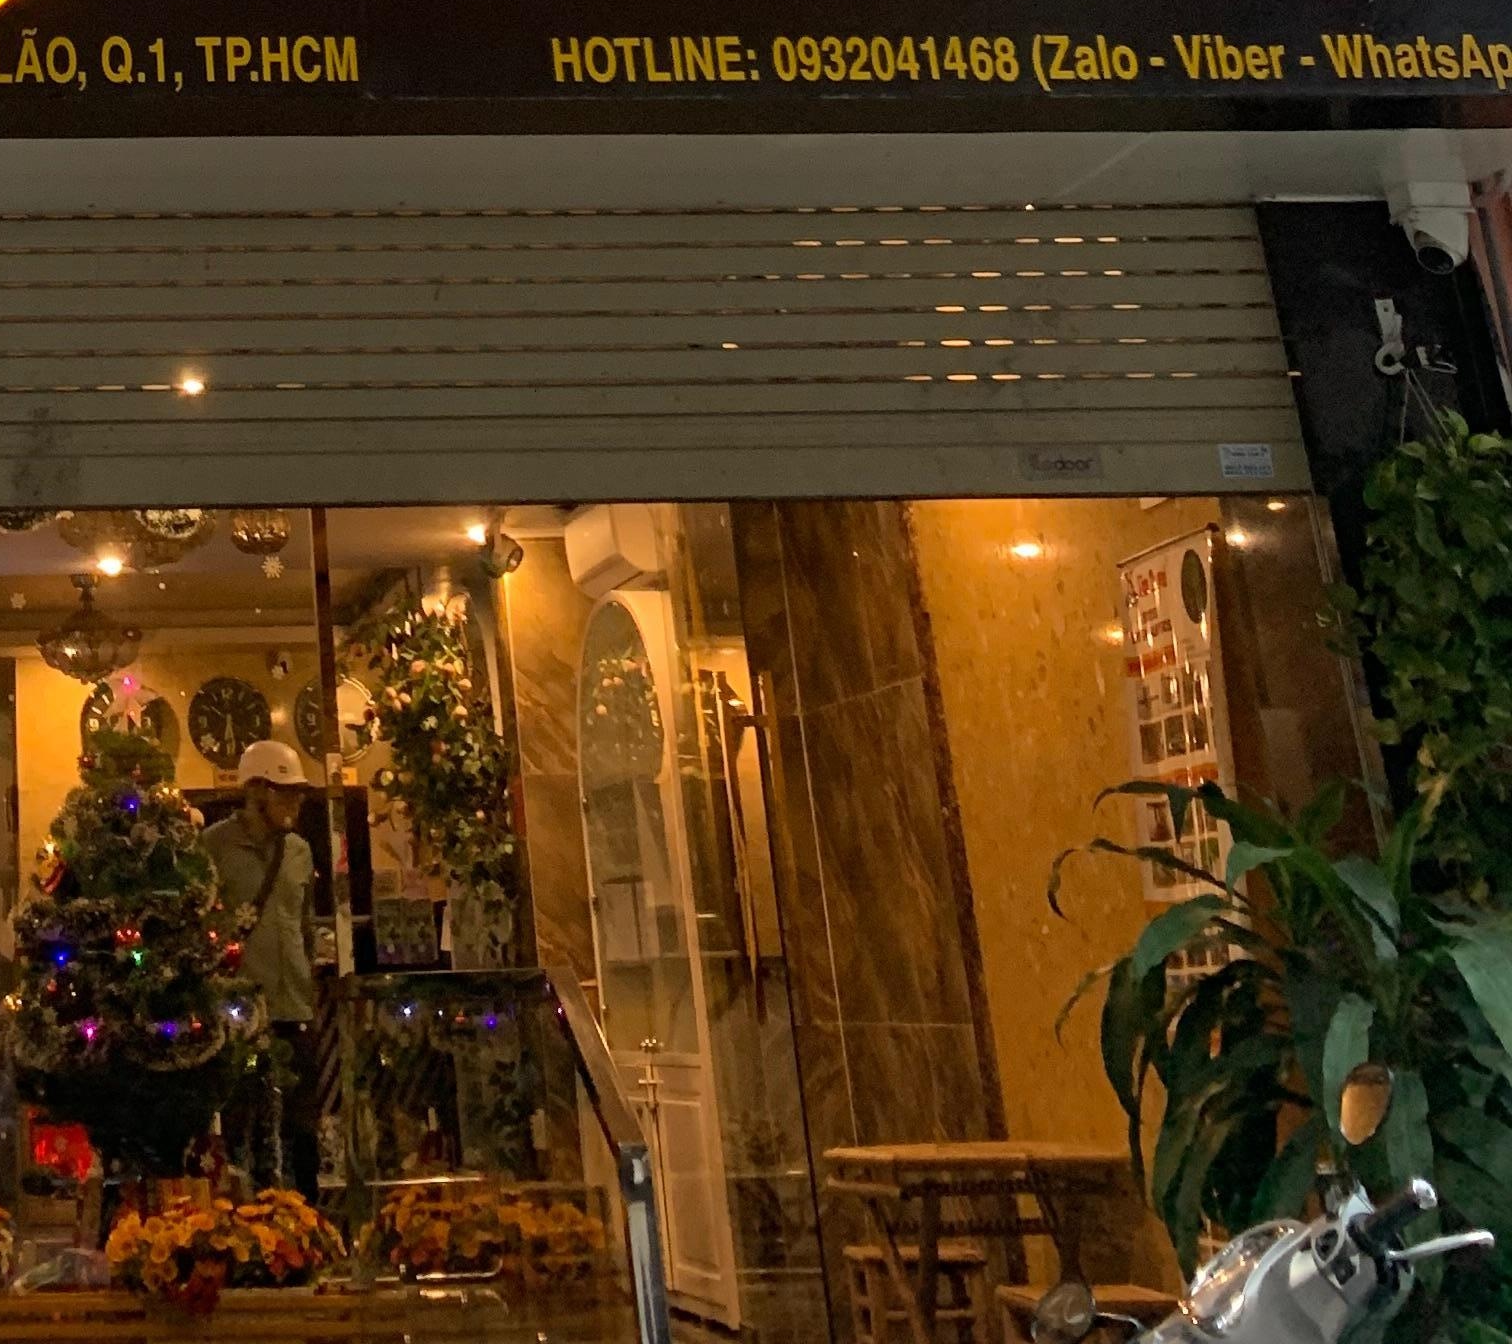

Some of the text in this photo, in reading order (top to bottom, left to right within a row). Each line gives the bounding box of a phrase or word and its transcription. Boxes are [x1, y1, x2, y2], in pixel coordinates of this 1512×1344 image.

[101, 35, 183, 92] Q.1,
[194, 36, 359, 82] TP.HCM
[551, 35, 761, 84] HOTLINE:
[771, 35, 1020, 82] 0932041468
[1032, 33, 1139, 92] (Zalo
[1172, 33, 1286, 81] Viber
